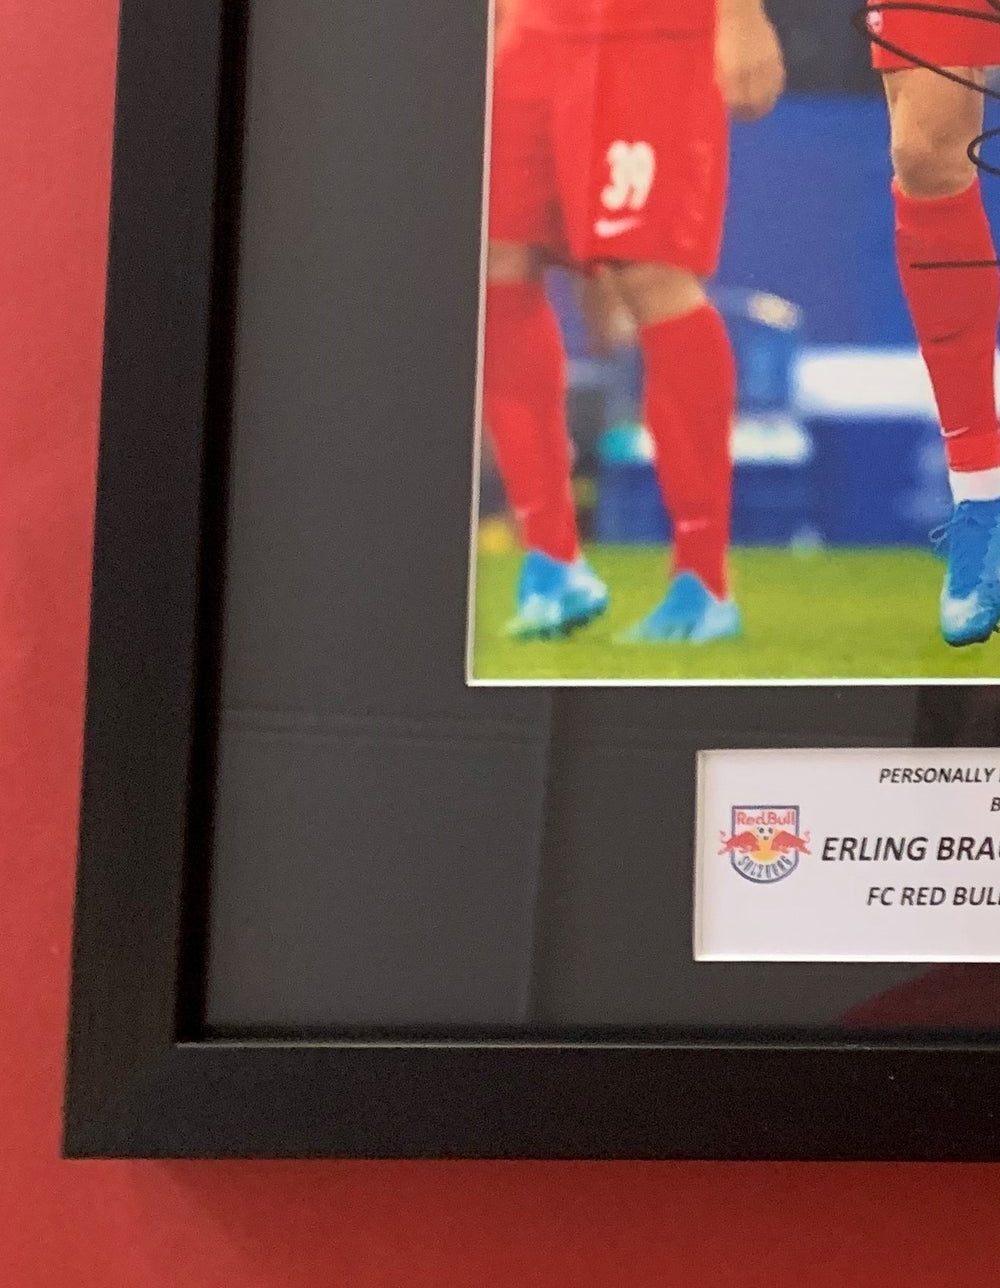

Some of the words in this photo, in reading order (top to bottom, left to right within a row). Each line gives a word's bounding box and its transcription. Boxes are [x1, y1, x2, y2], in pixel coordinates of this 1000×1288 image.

[601, 140, 656, 210] 39
[879, 767, 995, 783] PERSONALLY
[821, 836, 928, 862] ERLING
[867, 886, 894, 906] FC
[900, 886, 946, 906] RED
